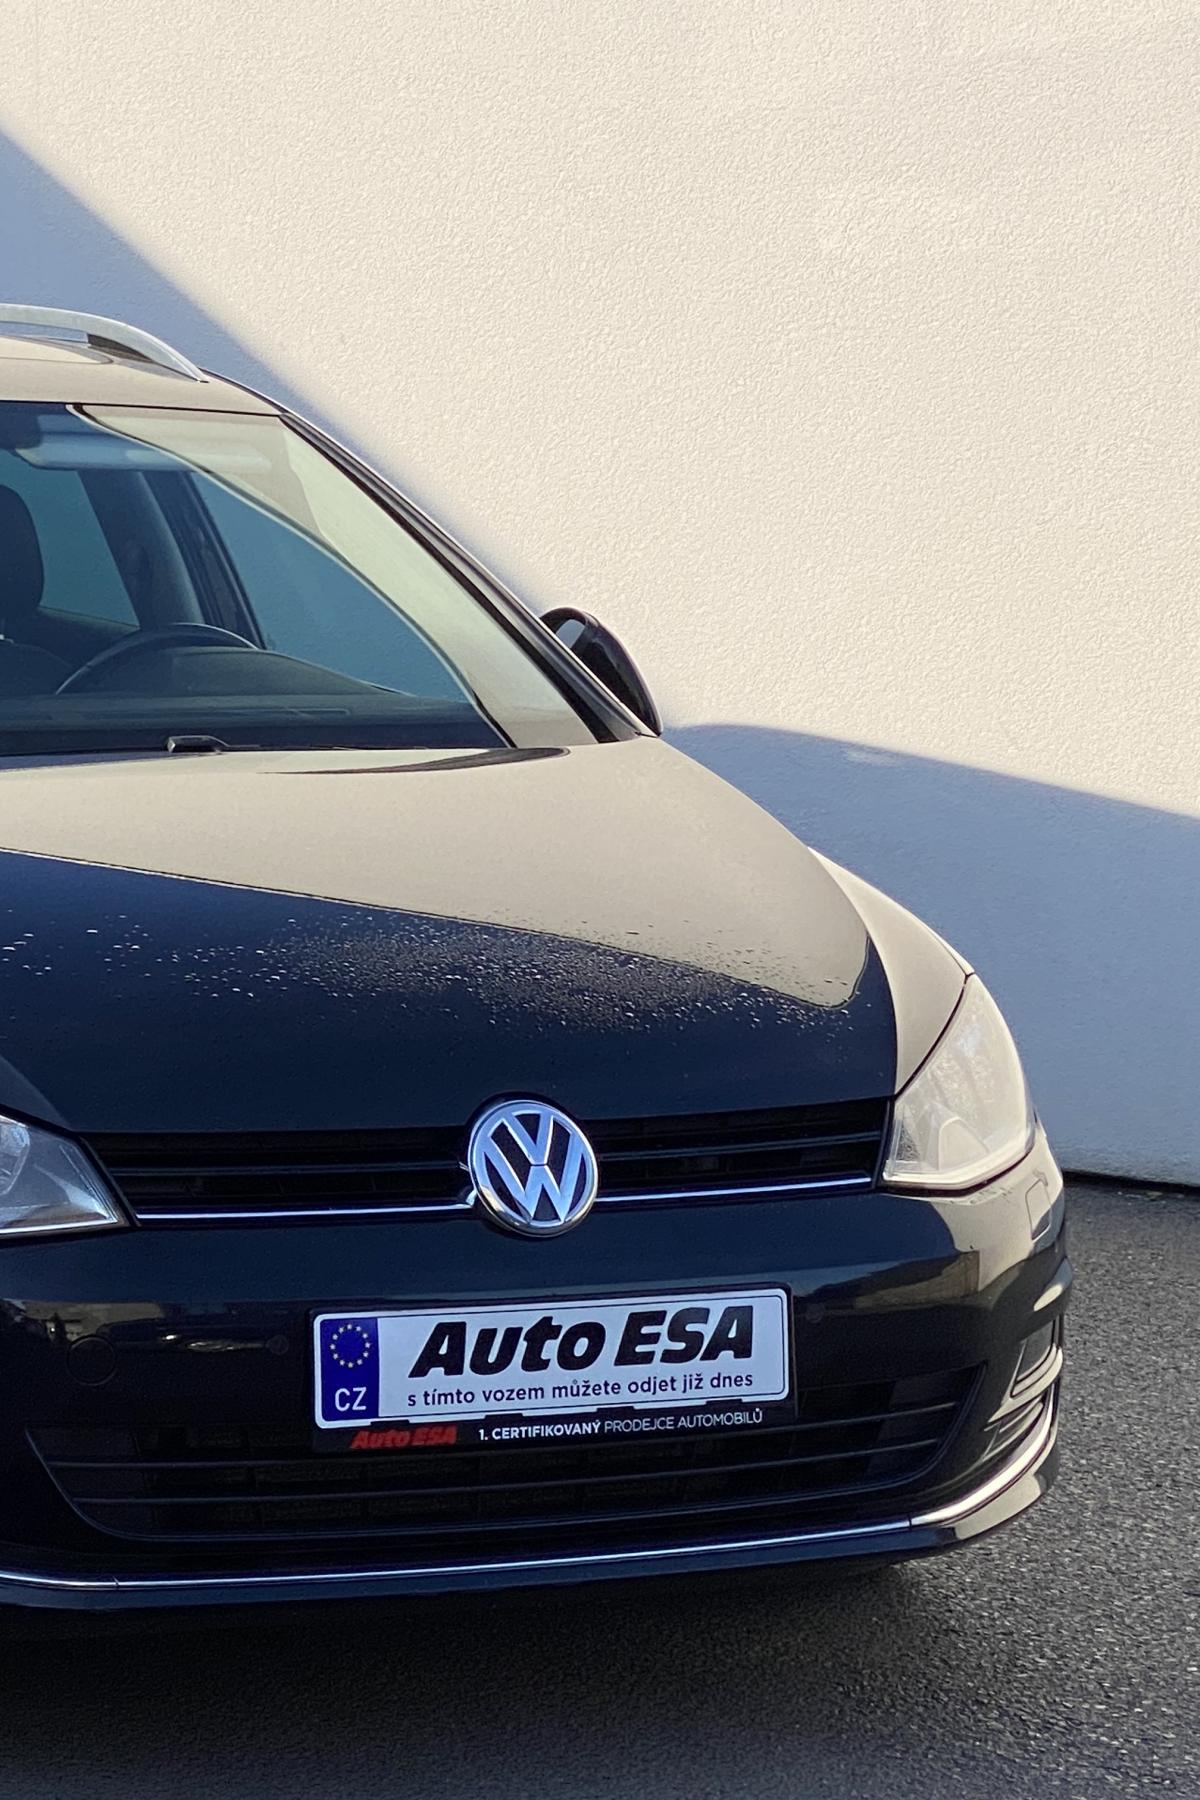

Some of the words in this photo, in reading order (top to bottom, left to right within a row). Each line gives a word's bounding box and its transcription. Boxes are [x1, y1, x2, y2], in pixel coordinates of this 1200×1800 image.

[407, 1315, 607, 1379] Auto
[613, 1304, 754, 1367] ESA
[334, 1387, 368, 1411] CZ
[407, 1394, 417, 1407] s
[422, 1388, 476, 1407] tímto
[481, 1388, 545, 1403] vozem
[552, 1378, 621, 1398] můžete
[627, 1375, 677, 1395] odjet
[681, 1372, 704, 1394] již
[709, 1371, 753, 1390] dnes
[351, 1428, 411, 1449] Auto
[410, 1424, 457, 1446] ESA
[478, 1427, 489, 1441] 1.
[491, 1420, 601, 1440] CERTIFIKOVANÝ
[604, 1416, 675, 1433] PRODEJCE
[677, 1407, 764, 1429] AUTOMOBILŮ
